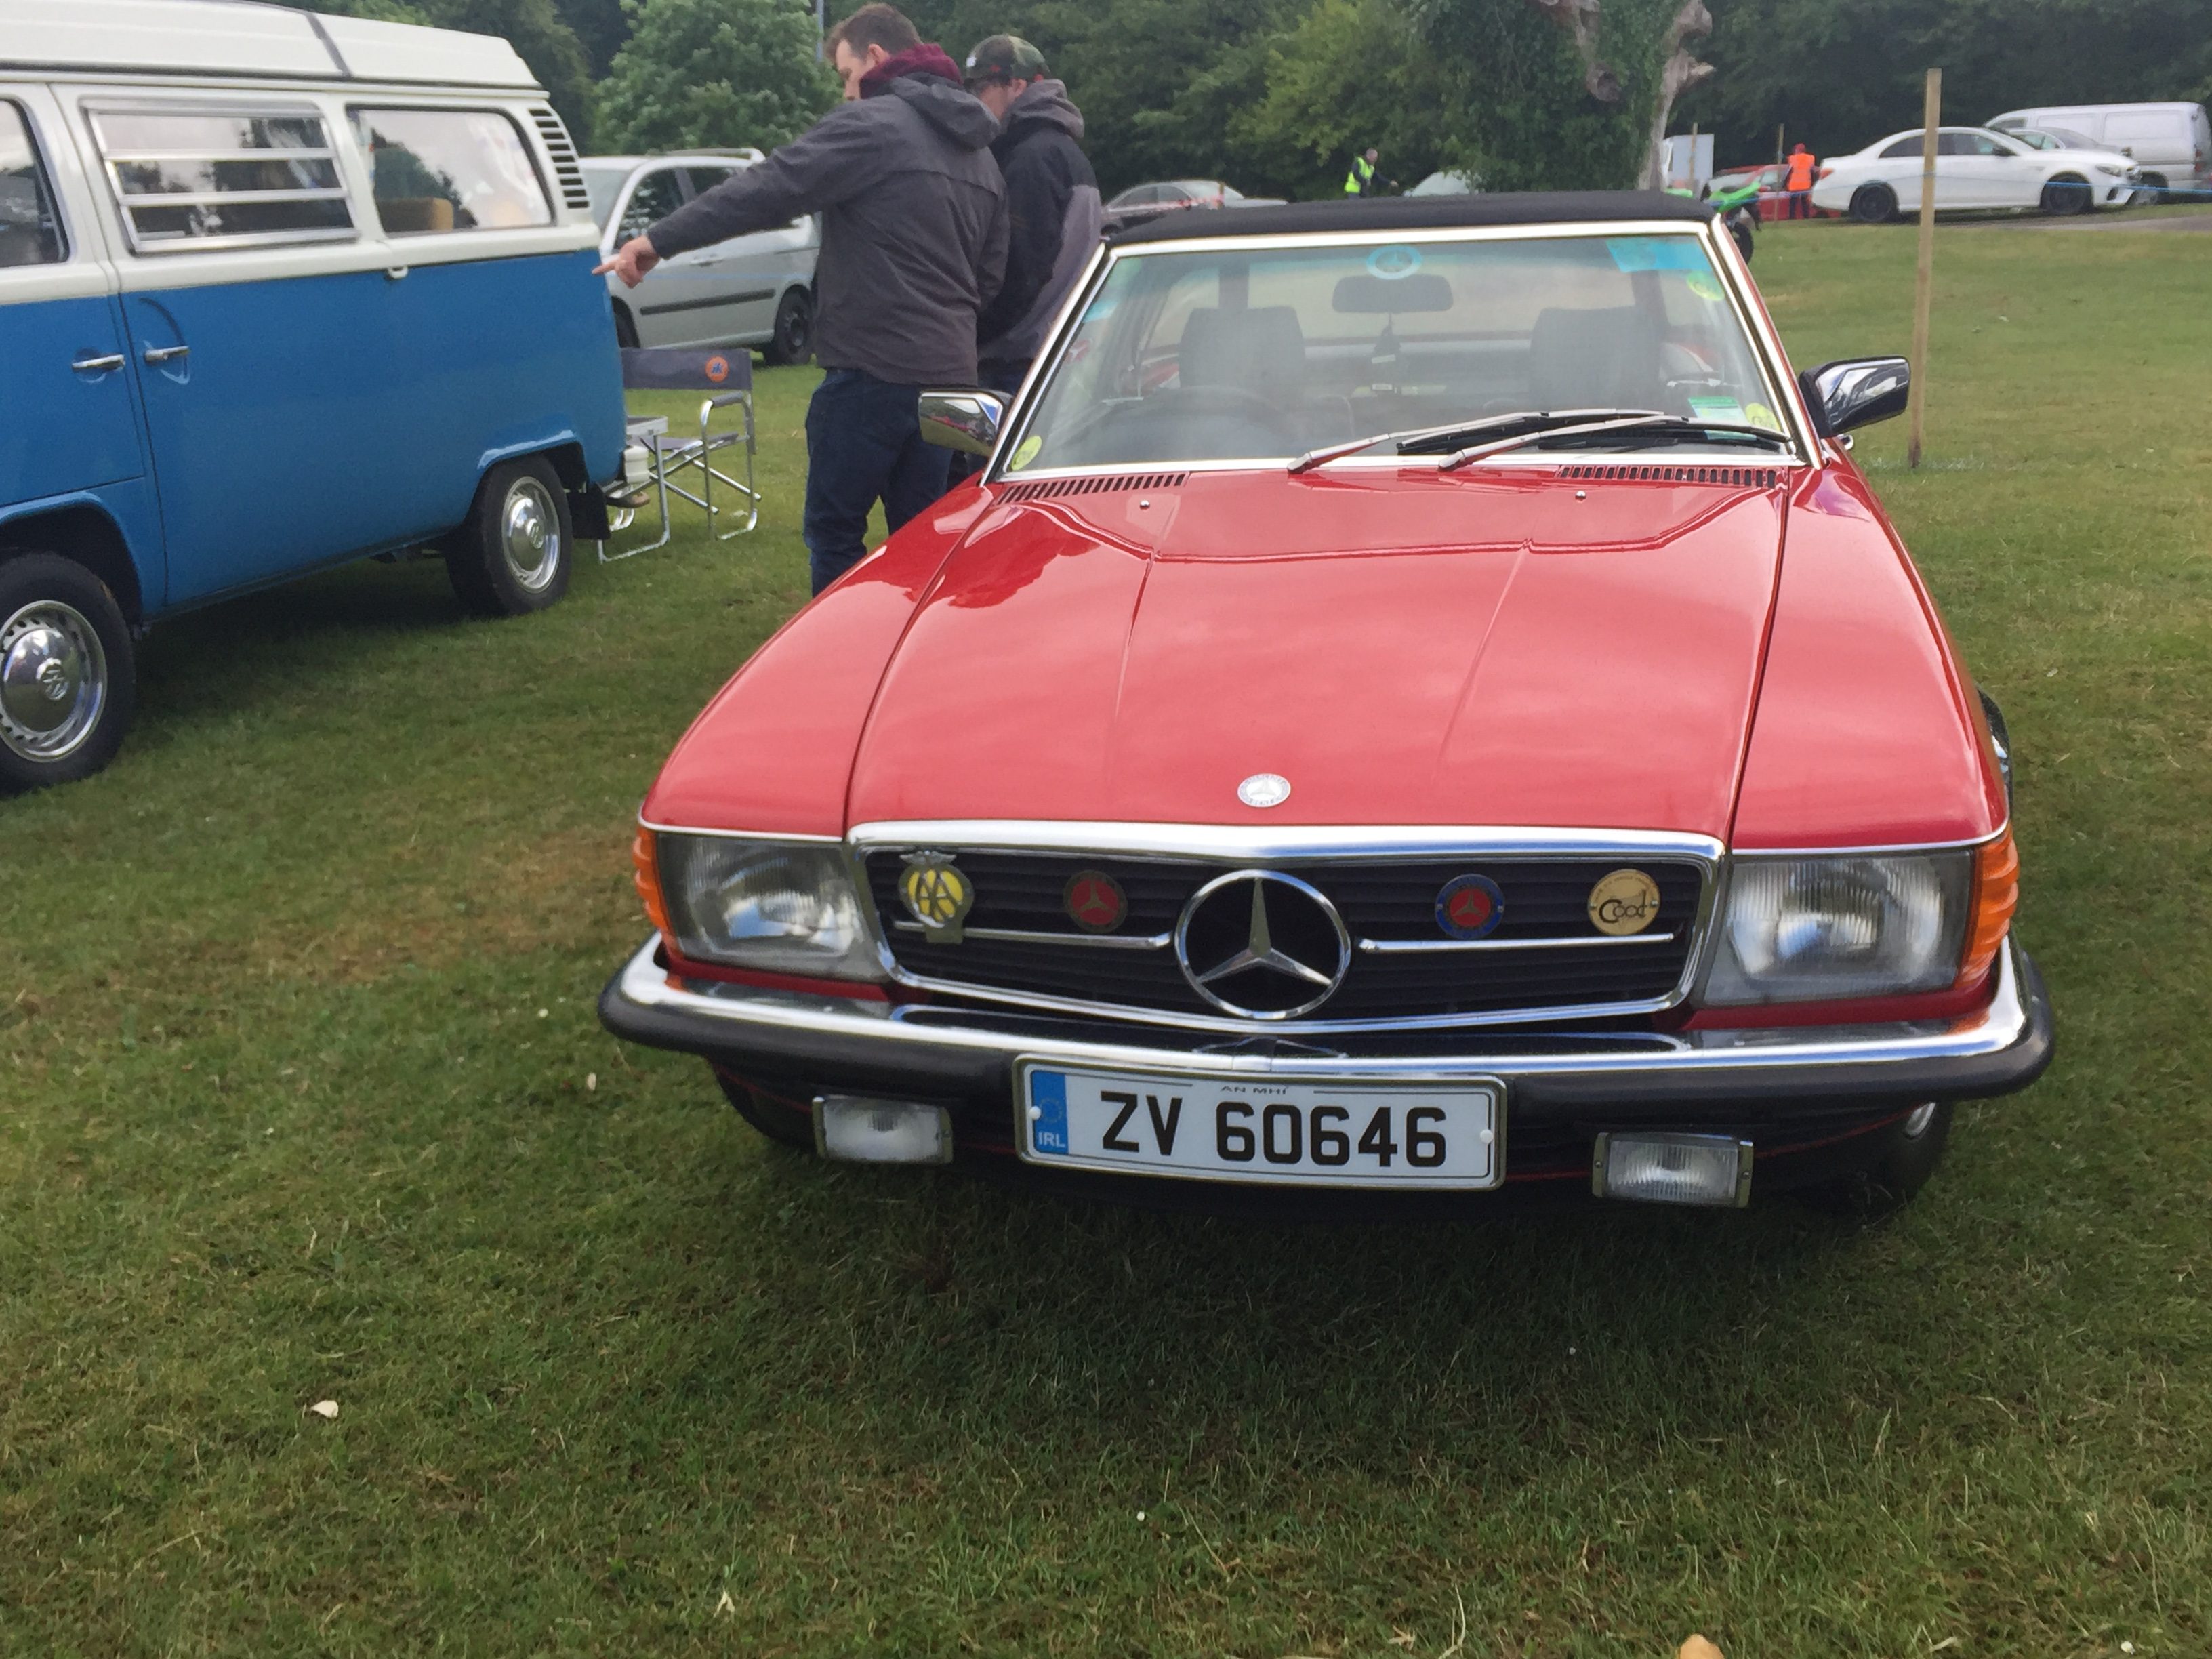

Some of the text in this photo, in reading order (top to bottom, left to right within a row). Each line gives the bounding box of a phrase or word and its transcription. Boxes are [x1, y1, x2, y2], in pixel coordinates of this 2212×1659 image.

[1038, 1131, 1065, 1148] IRL
[1100, 1090, 1447, 1168] ZV 60646
